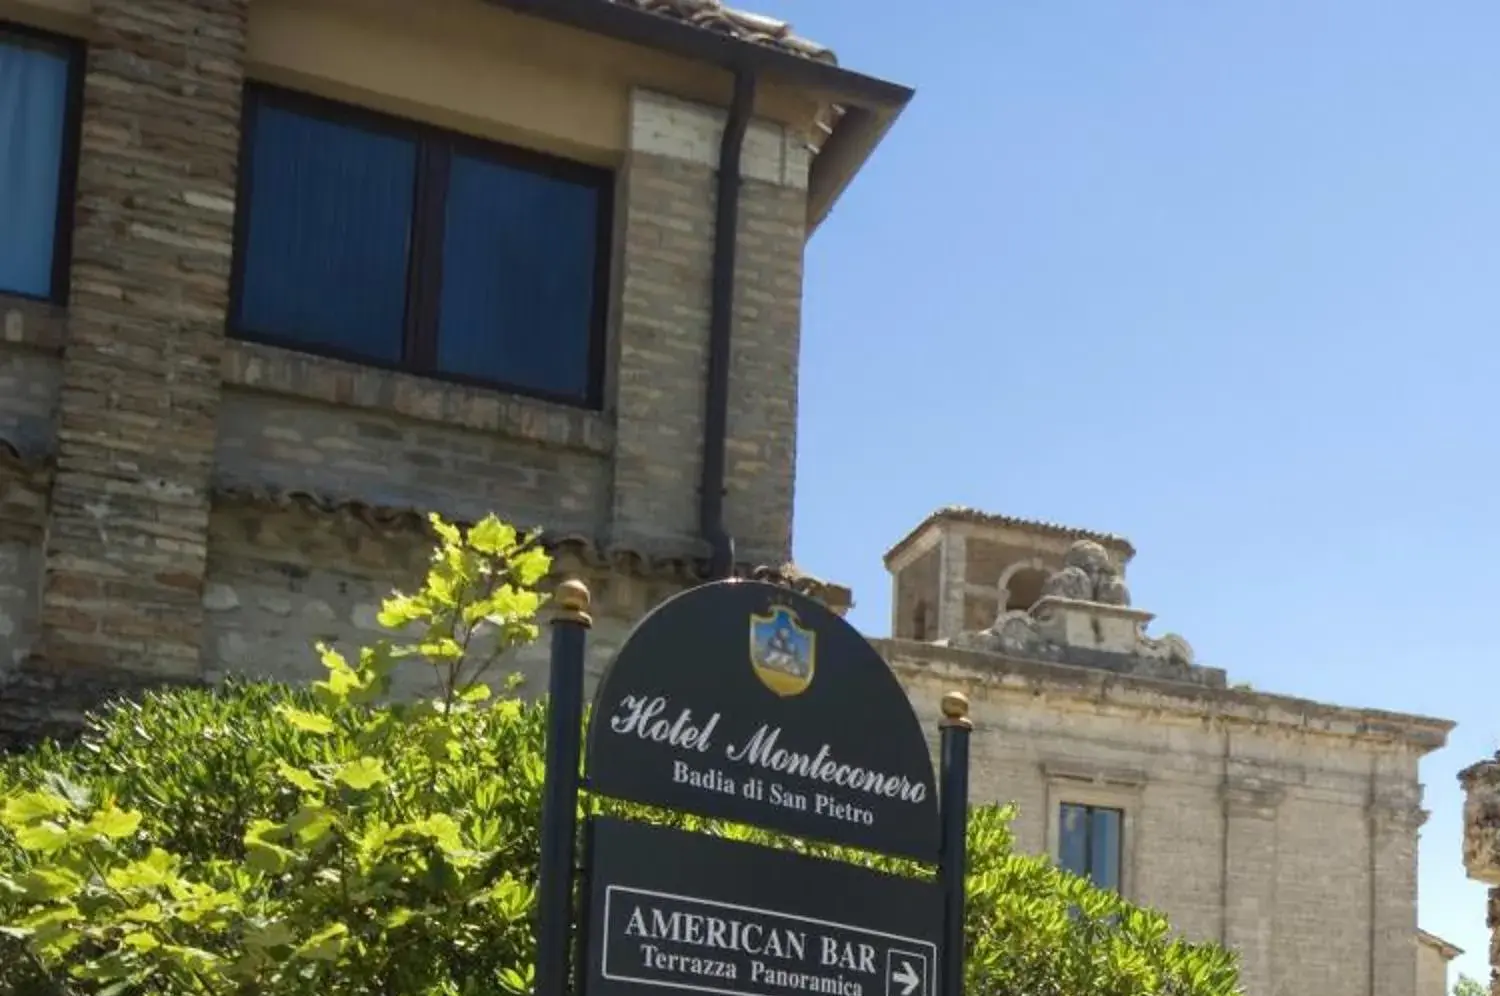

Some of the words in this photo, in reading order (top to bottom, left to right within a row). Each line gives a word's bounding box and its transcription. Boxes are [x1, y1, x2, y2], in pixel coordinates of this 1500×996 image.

[610, 694, 721, 753] Hotel
[726, 723, 928, 804] Monteconero
[672, 760, 736, 796] Badia
[743, 777, 765, 801] di
[769, 783, 807, 811] San
[815, 793, 875, 827] Pietro
[624, 906, 806, 961] AMERICAN
[820, 935, 877, 975] BAR
[640, 944, 737, 980] Terrazza
